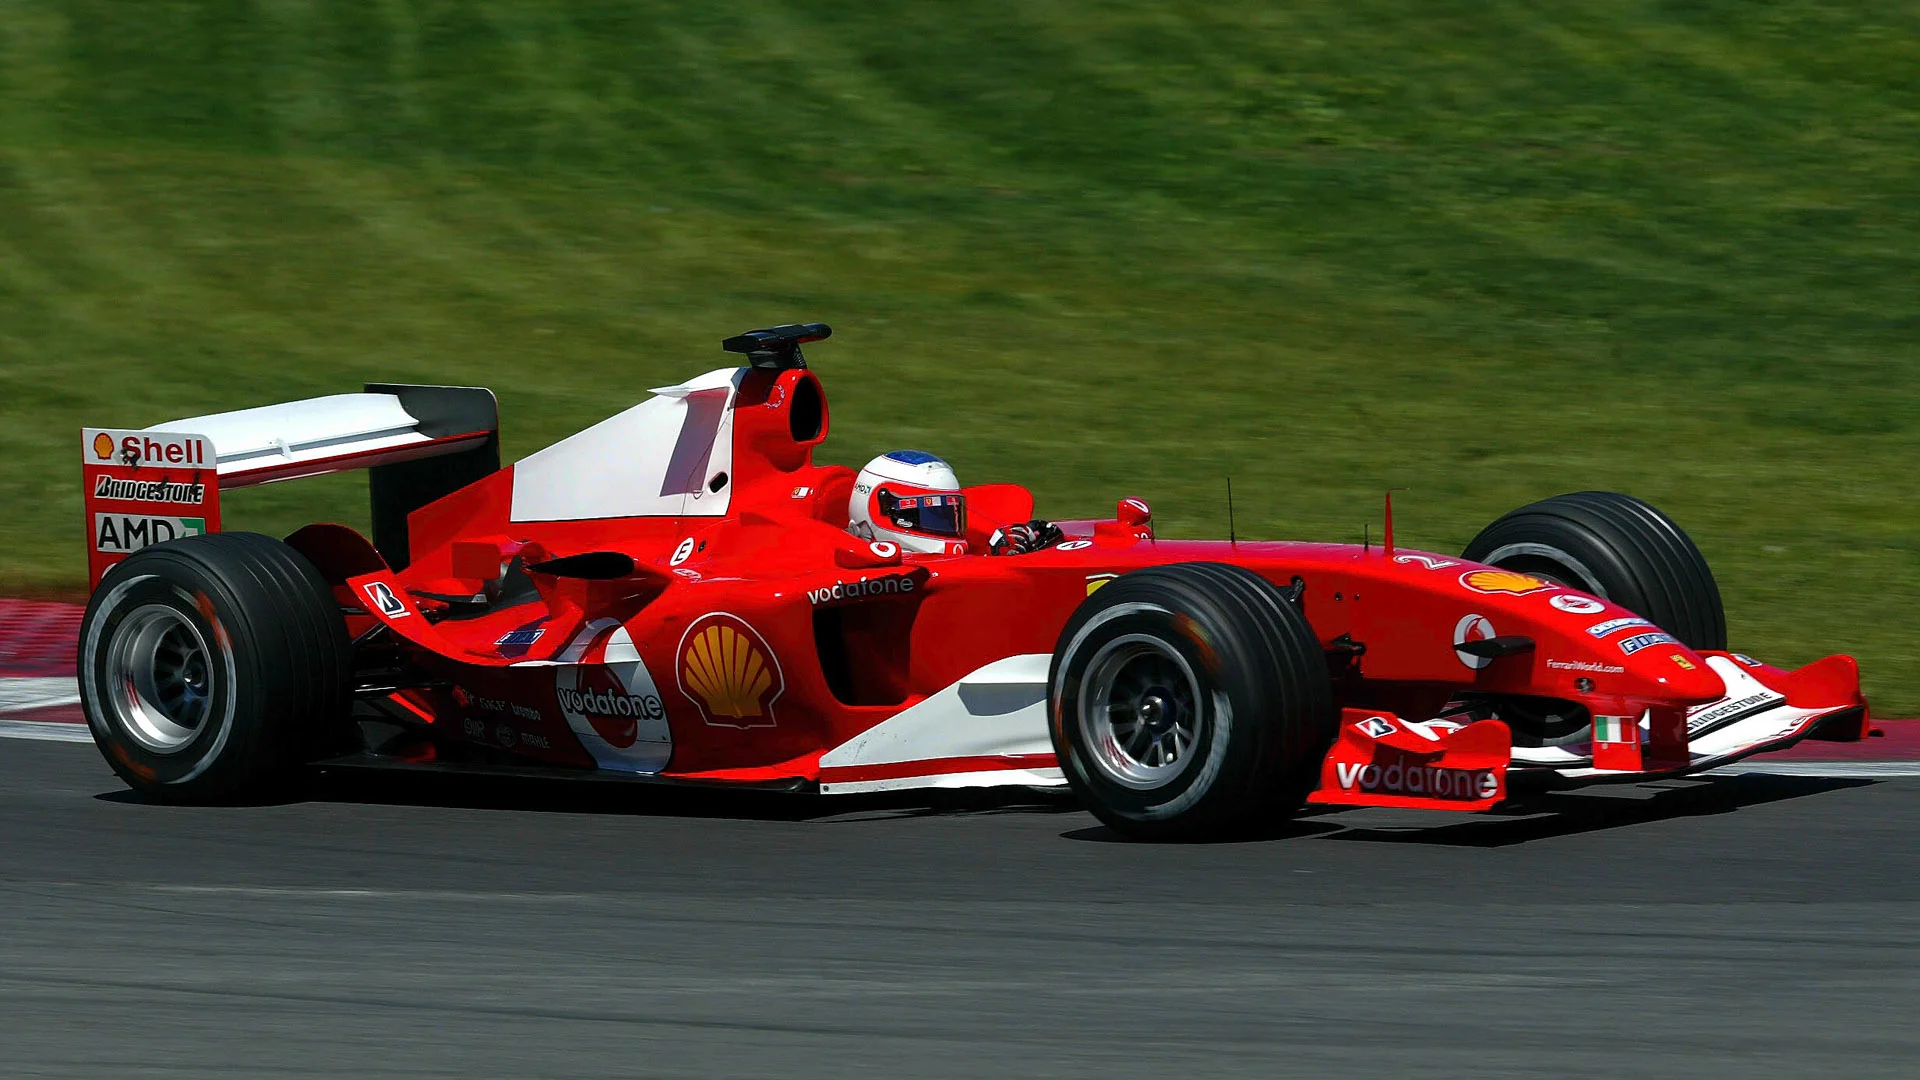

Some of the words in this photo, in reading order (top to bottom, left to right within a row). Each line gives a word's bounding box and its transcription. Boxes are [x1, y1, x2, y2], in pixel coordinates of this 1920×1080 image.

[121, 436, 203, 464] Shell
[95, 475, 204, 504] BRIDGESTONE
[98, 516, 175, 549] AMD
[1393, 555, 1461, 570] 2
[807, 576, 914, 605] vodafone
[558, 688, 663, 720] vodafone
[1336, 755, 1498, 798] vodafone
